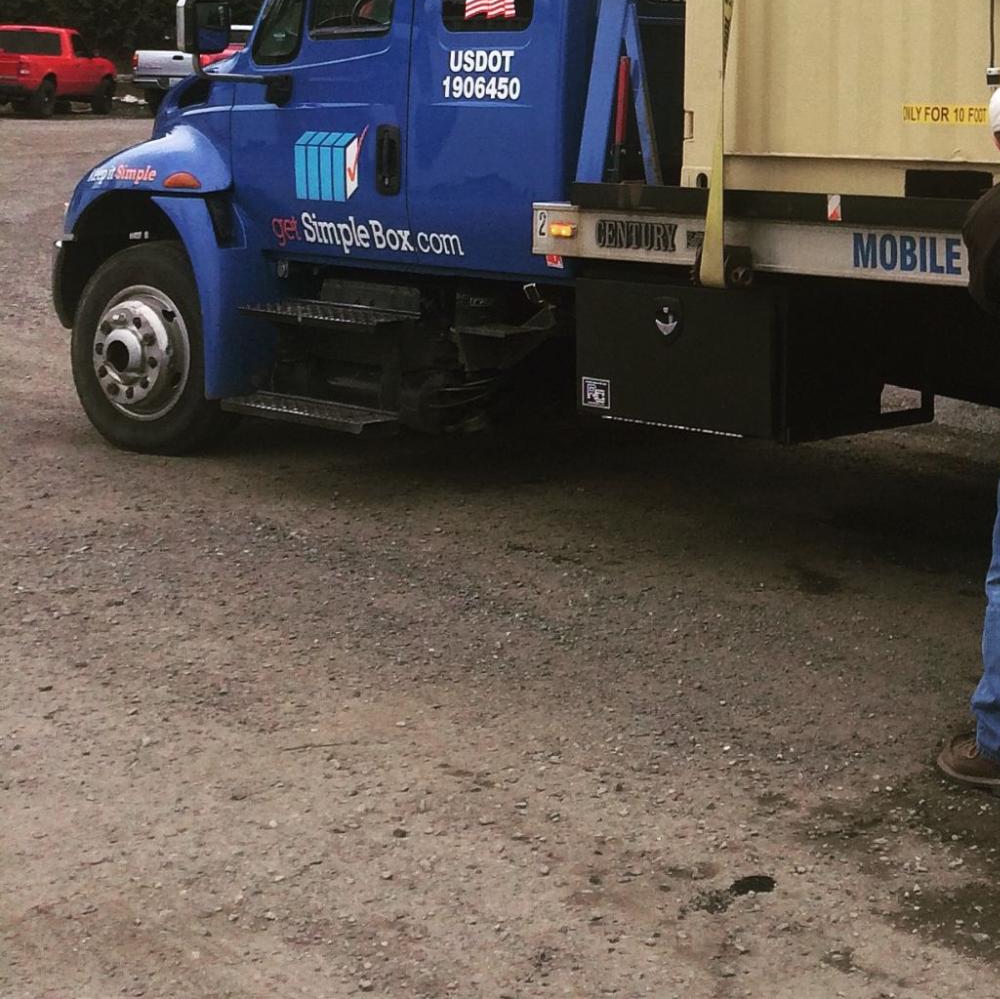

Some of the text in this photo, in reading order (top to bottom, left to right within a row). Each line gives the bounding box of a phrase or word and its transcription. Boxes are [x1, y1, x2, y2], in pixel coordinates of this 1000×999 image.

[449, 49, 515, 73] USDOT
[442, 75, 521, 100] 1906450
[924, 106, 949, 122] FOR
[953, 107, 965, 122] 10
[115, 164, 157, 185] Simple
[595, 218, 679, 252] CENTURY
[852, 232, 962, 275] MOBILE
